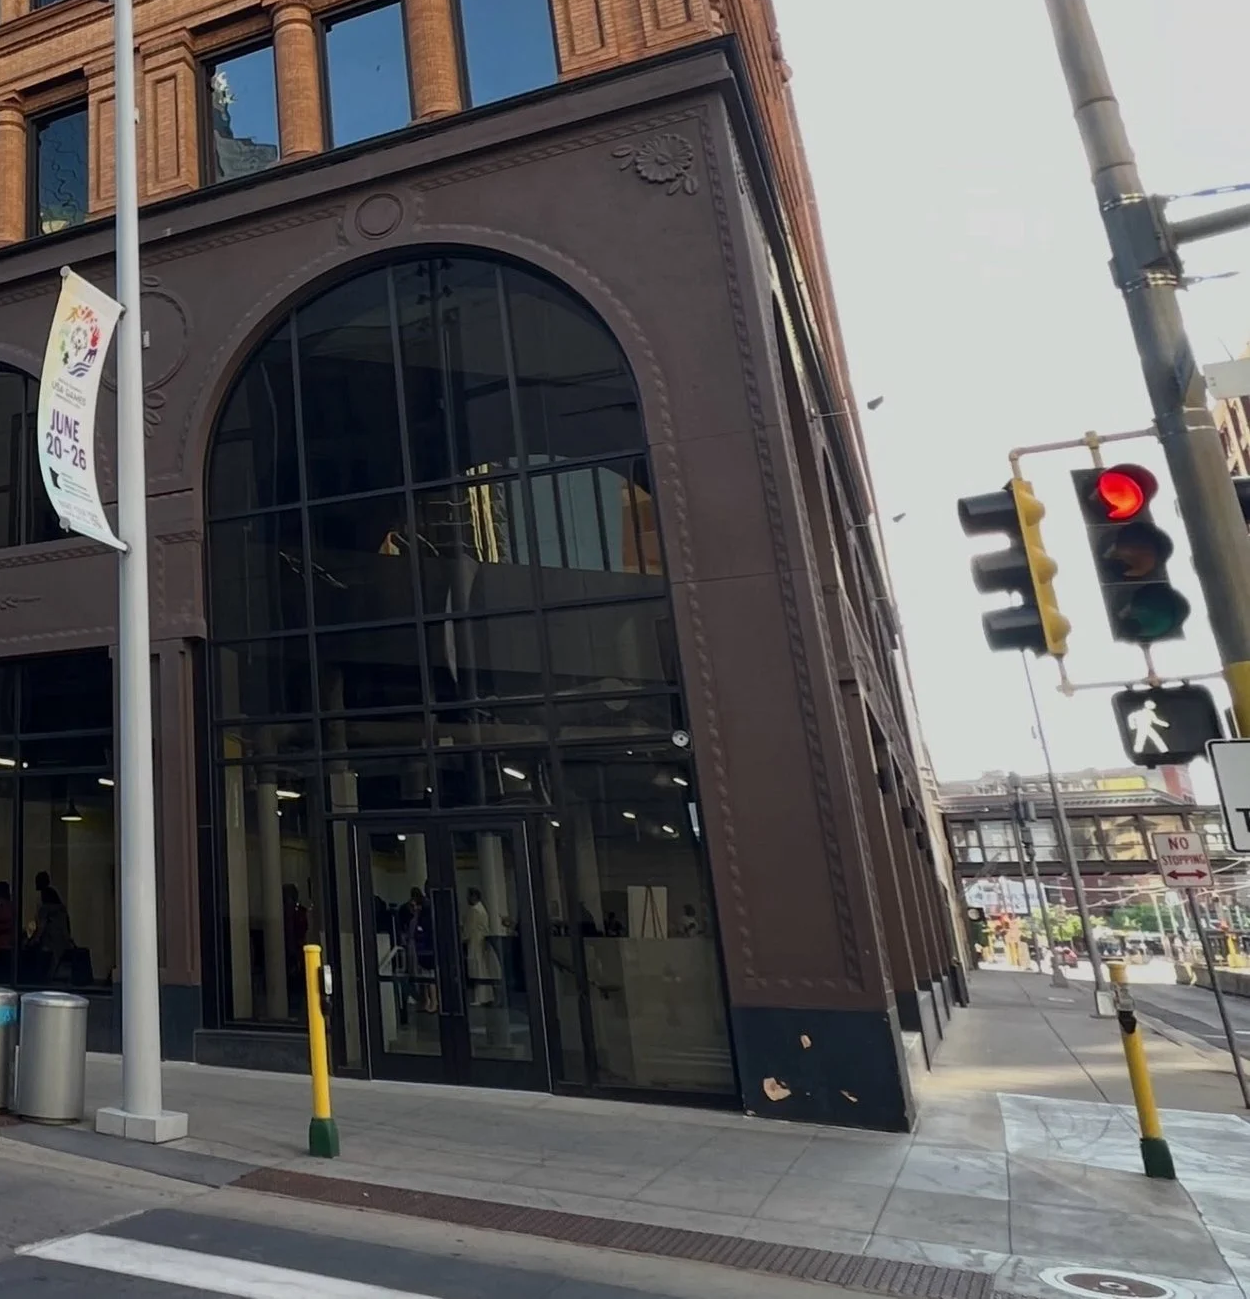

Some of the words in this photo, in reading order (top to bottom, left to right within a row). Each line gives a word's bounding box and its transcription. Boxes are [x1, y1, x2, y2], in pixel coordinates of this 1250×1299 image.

[50, 408, 80, 444] JUNE
[46, 432, 87, 471] 20-26
[1167, 836, 1189, 851] NO
[1161, 853, 1207, 866] STOPPING
